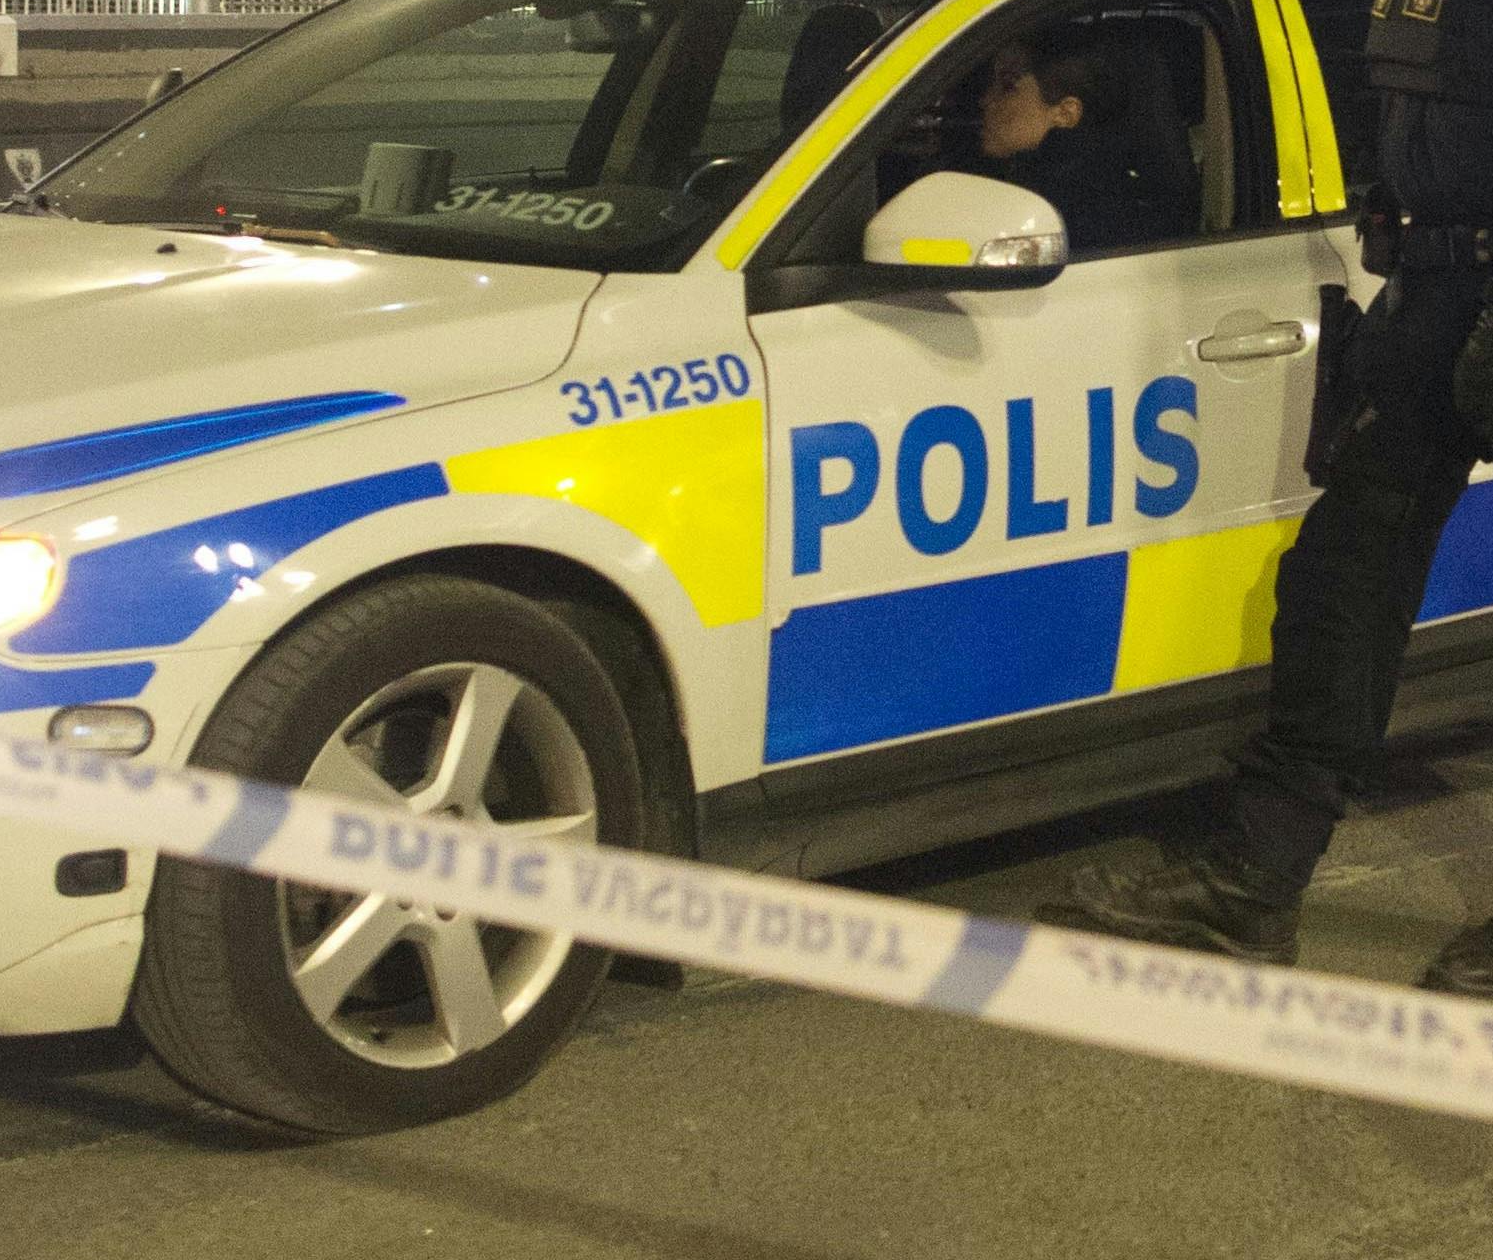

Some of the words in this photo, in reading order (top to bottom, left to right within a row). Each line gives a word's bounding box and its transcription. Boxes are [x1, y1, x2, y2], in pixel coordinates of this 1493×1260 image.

[434, 185, 615, 231] 31-1250
[559, 353, 751, 427] 31-1250
[790, 375, 1200, 577] POLIS
